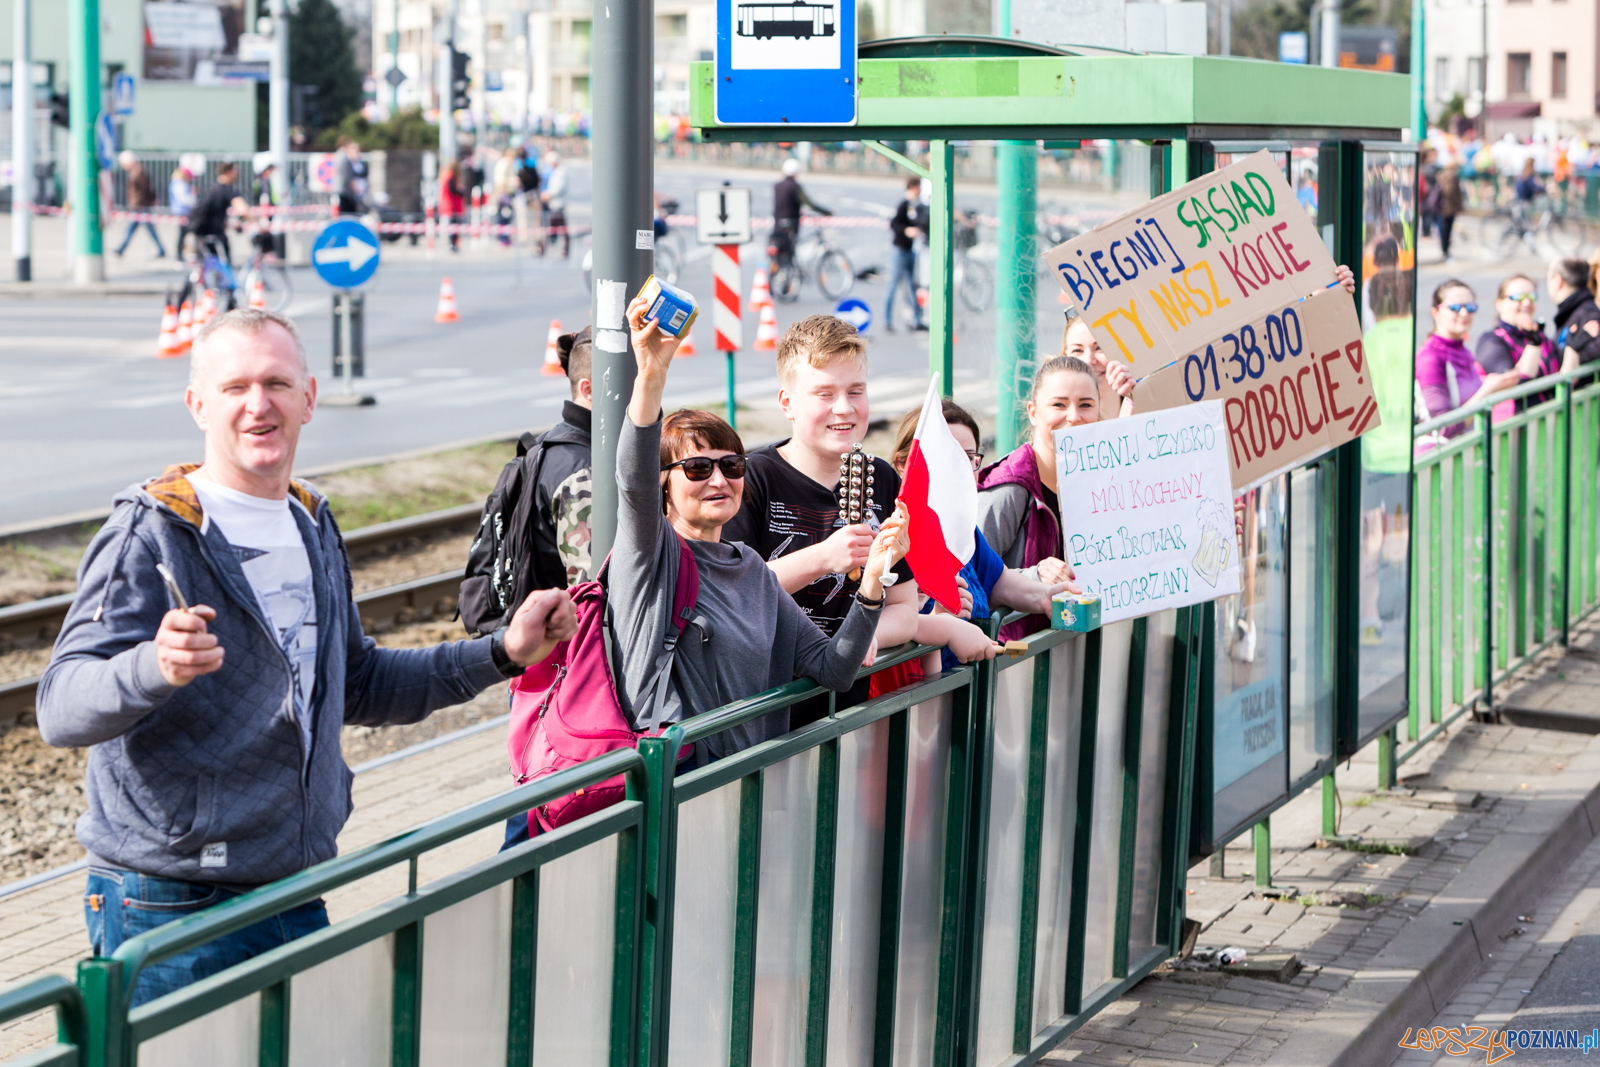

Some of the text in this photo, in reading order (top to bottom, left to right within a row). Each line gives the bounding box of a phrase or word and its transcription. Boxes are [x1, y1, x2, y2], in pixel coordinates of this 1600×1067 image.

[1176, 172, 1275, 248] SĄSIAD
[1091, 222, 1311, 363] TY NASZ KOCIE
[1184, 307, 1302, 402] 01:38:00
[1060, 418, 1216, 476] BIEGNIJ SZYBKO
[1091, 472, 1203, 514] MÓJ KOCHANY
[1069, 523, 1187, 567] PÓKI BROWAR
